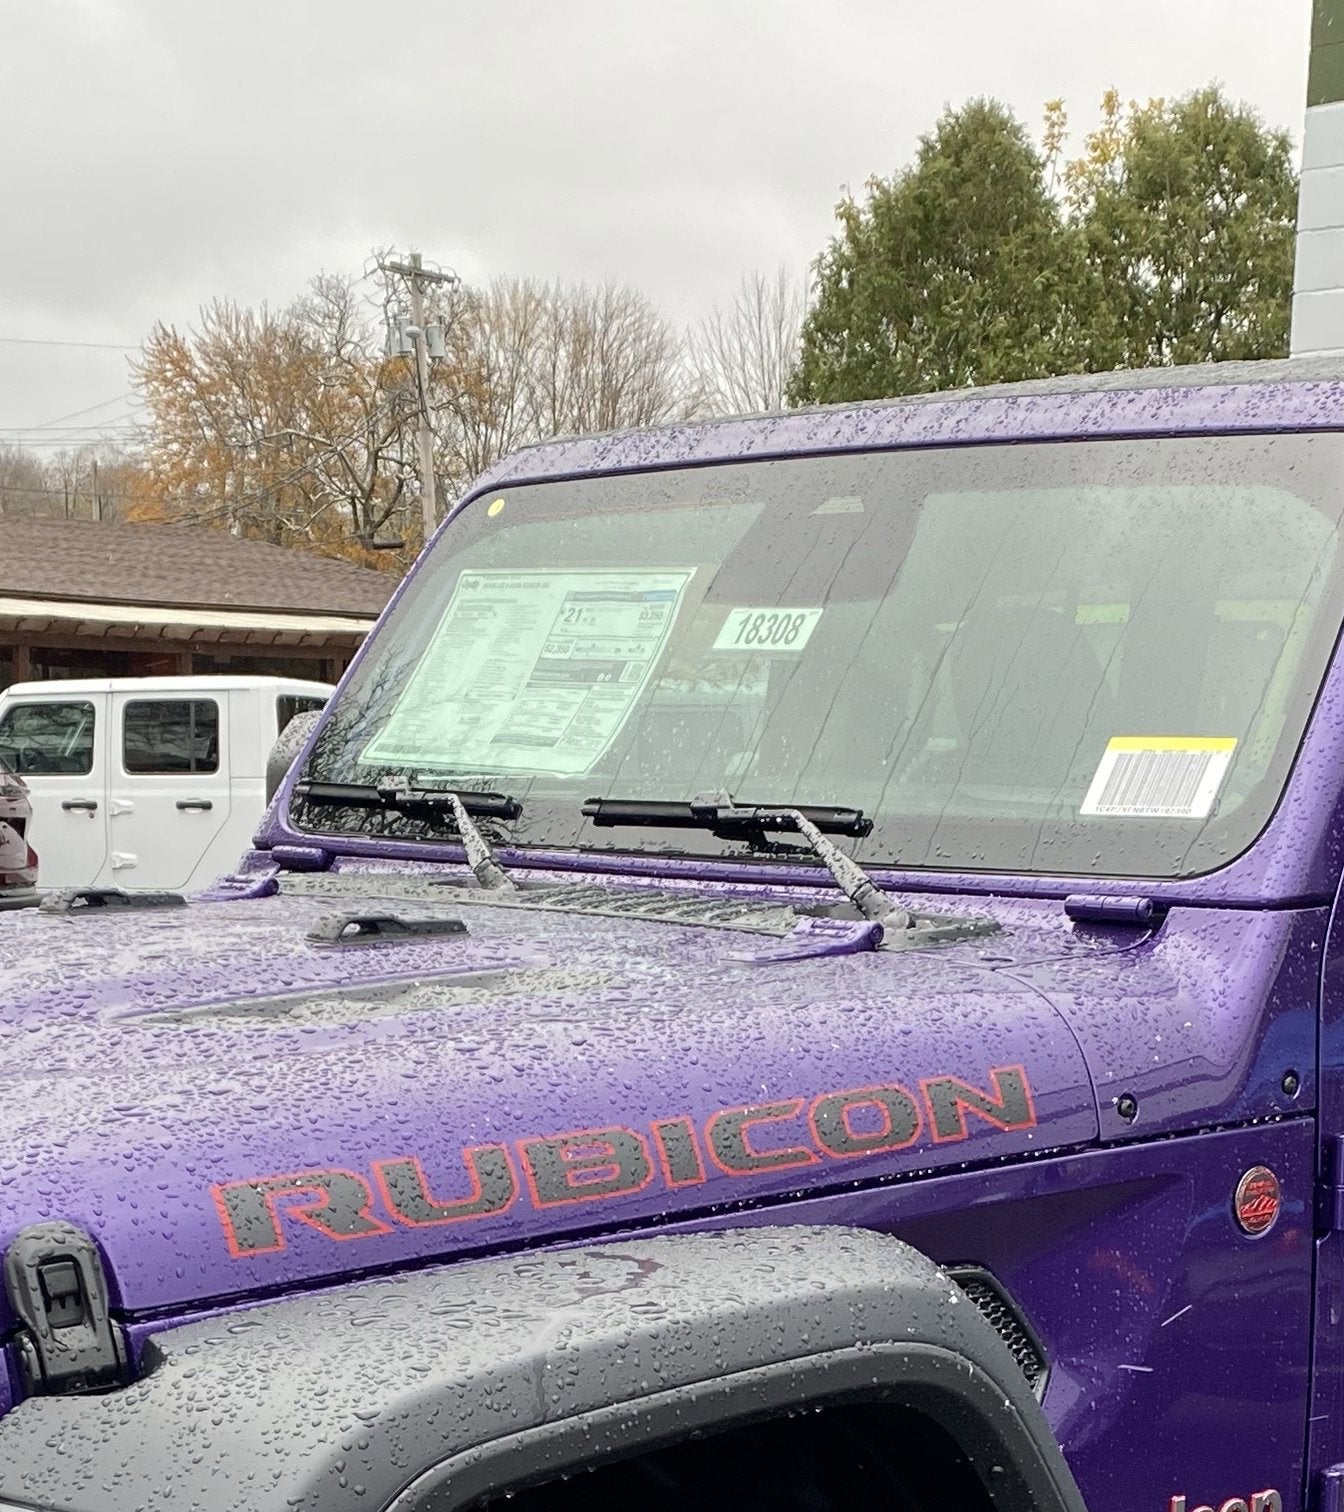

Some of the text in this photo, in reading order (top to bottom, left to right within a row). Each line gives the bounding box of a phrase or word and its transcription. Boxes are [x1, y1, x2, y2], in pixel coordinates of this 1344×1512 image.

[564, 608, 583, 623] 21
[735, 613, 806, 645] 18308
[211, 1064, 1040, 1260] RUBICON
